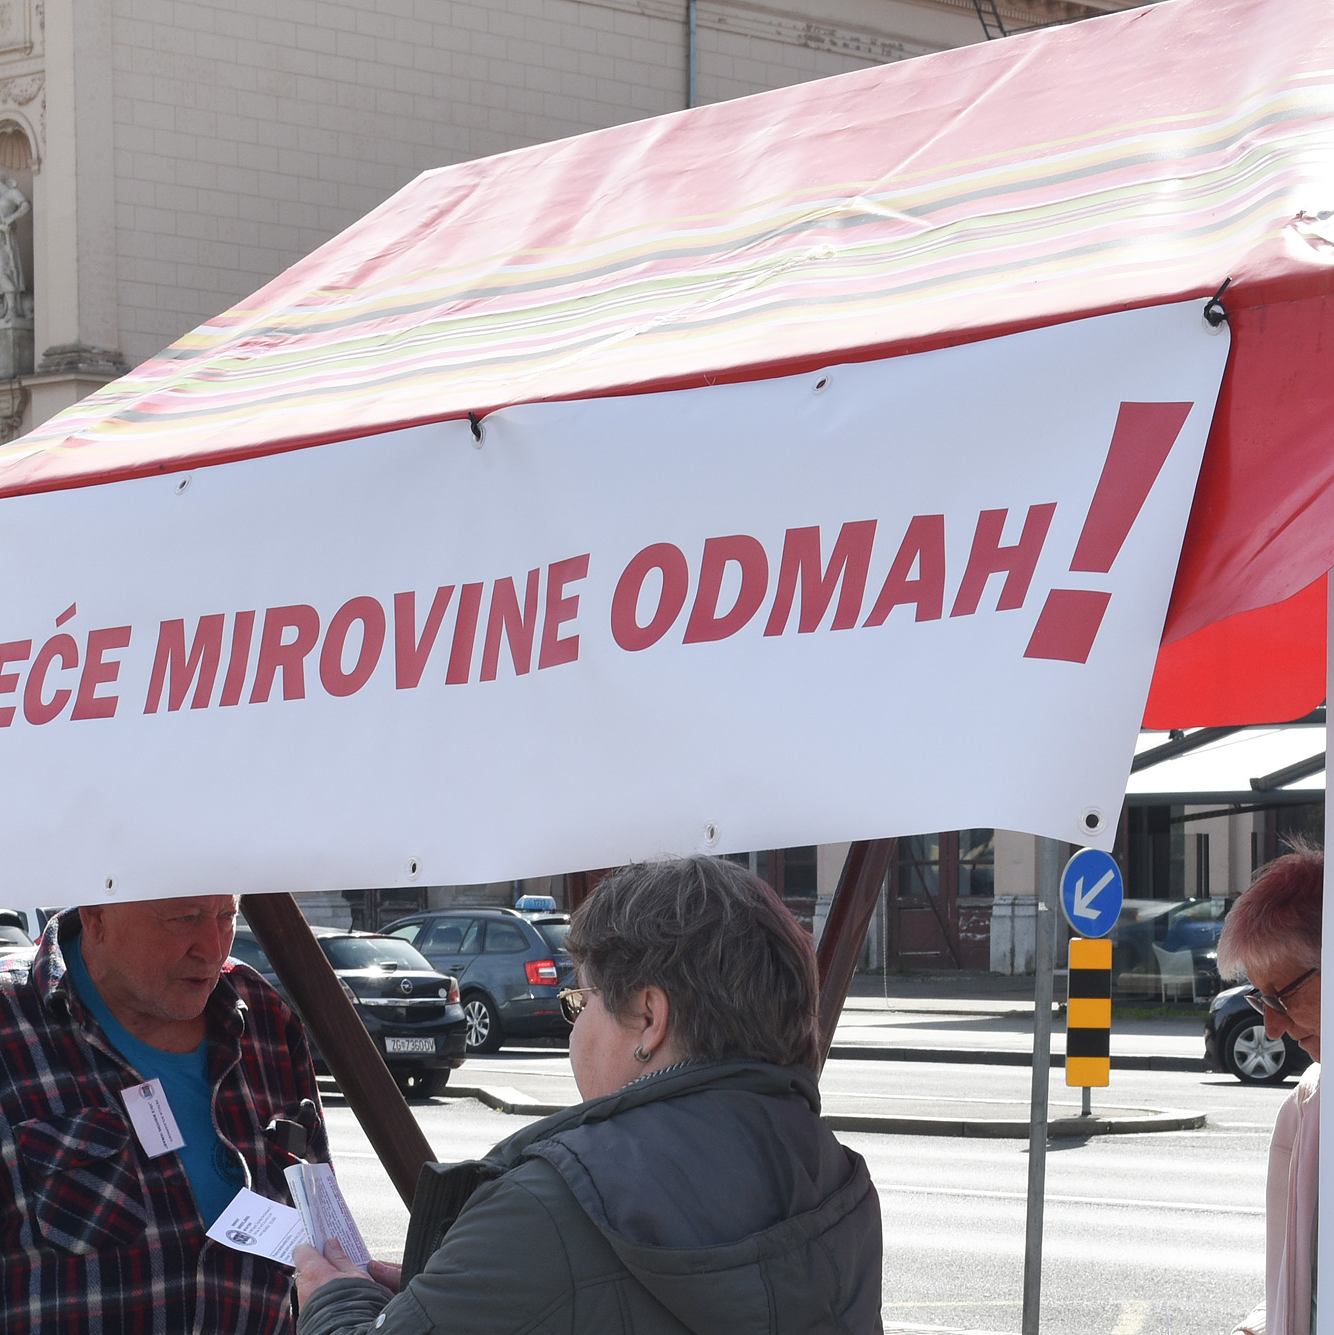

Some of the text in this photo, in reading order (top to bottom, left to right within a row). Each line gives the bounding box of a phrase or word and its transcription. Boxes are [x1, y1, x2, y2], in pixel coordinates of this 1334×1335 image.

[143, 553, 590, 714] MIROVINE
[611, 401, 1194, 664] ODMAH!
[391, 1040, 401, 1050] ZG
